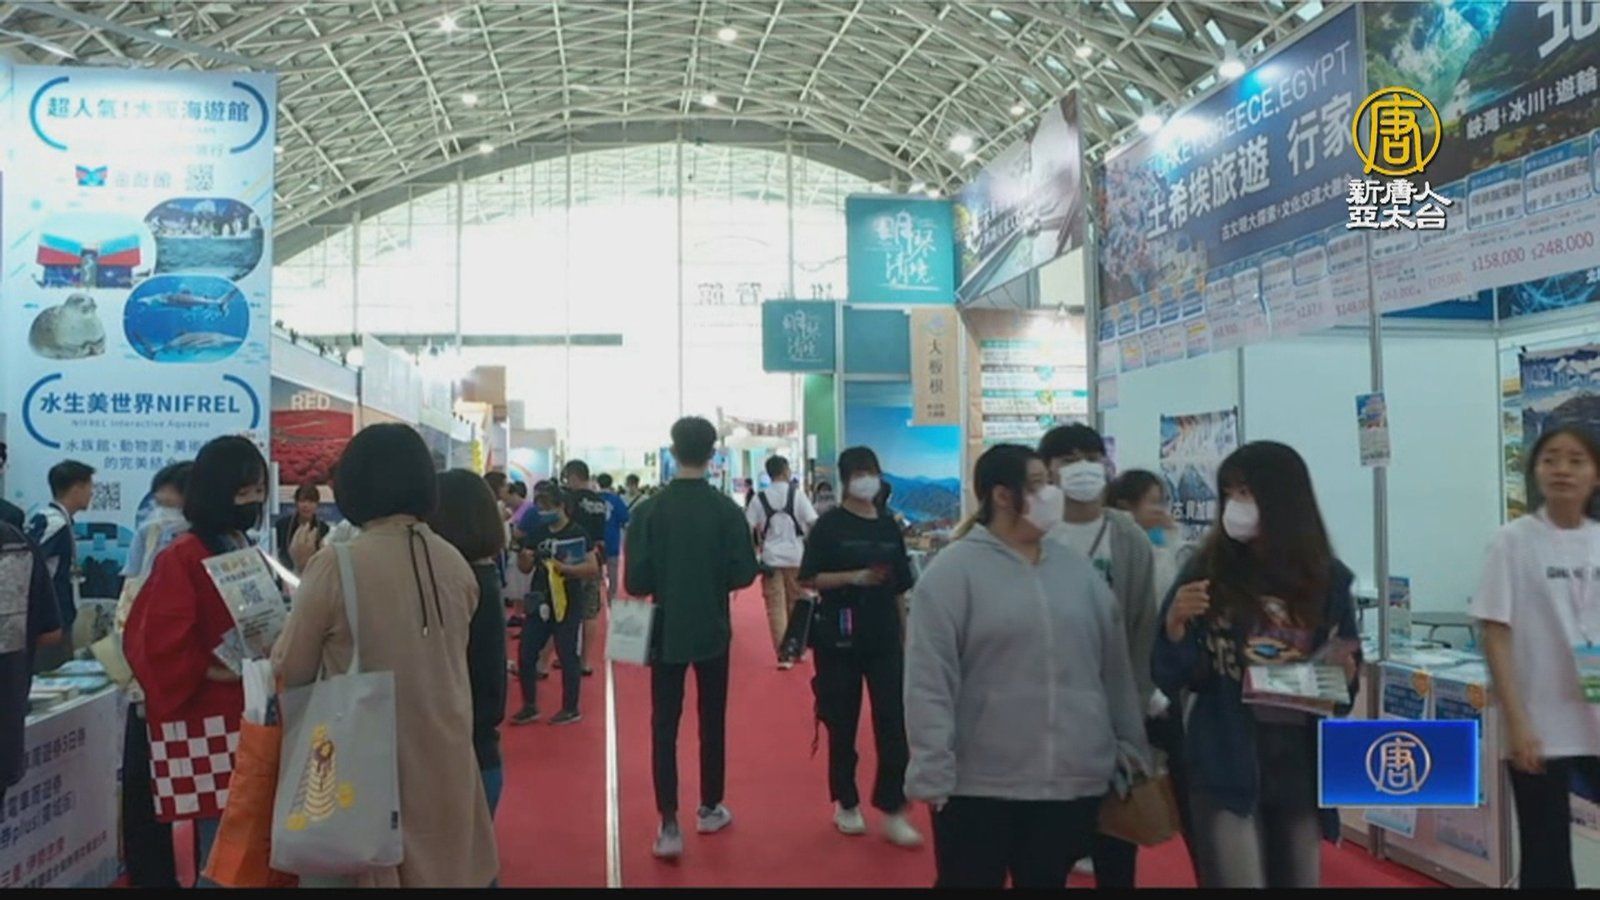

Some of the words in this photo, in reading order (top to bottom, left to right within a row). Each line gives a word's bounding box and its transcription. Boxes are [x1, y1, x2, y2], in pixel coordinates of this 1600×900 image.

[1146, 134, 1271, 240] 土希埃旅遊
[1287, 92, 1352, 176] 行家
[40, 392, 241, 414] 水生美世界NIFREL
[291, 393, 330, 411] RED
